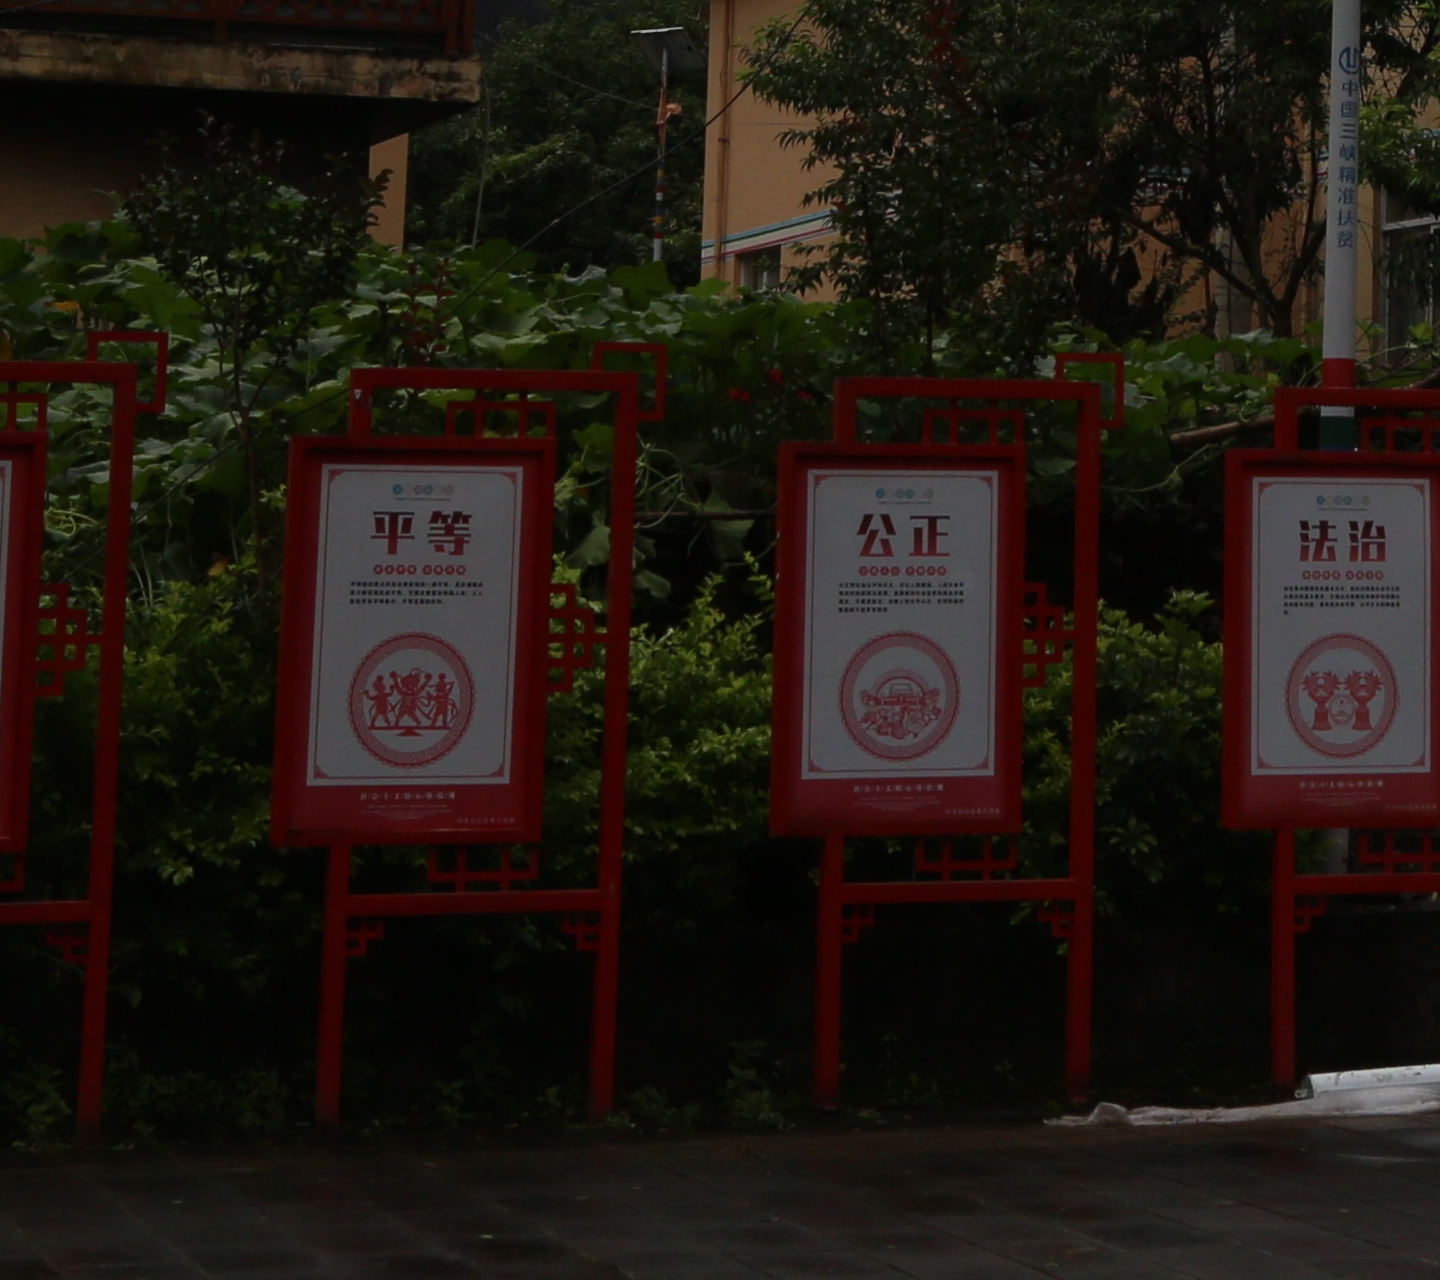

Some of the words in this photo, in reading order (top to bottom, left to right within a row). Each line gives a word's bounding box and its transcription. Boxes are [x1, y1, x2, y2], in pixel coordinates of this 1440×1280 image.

[1336, 78, 1358, 249] 中国三峡精准扶贫
[370, 510, 473, 556] 平等
[855, 513, 952, 558] 公正
[1298, 519, 1387, 563] 法治
